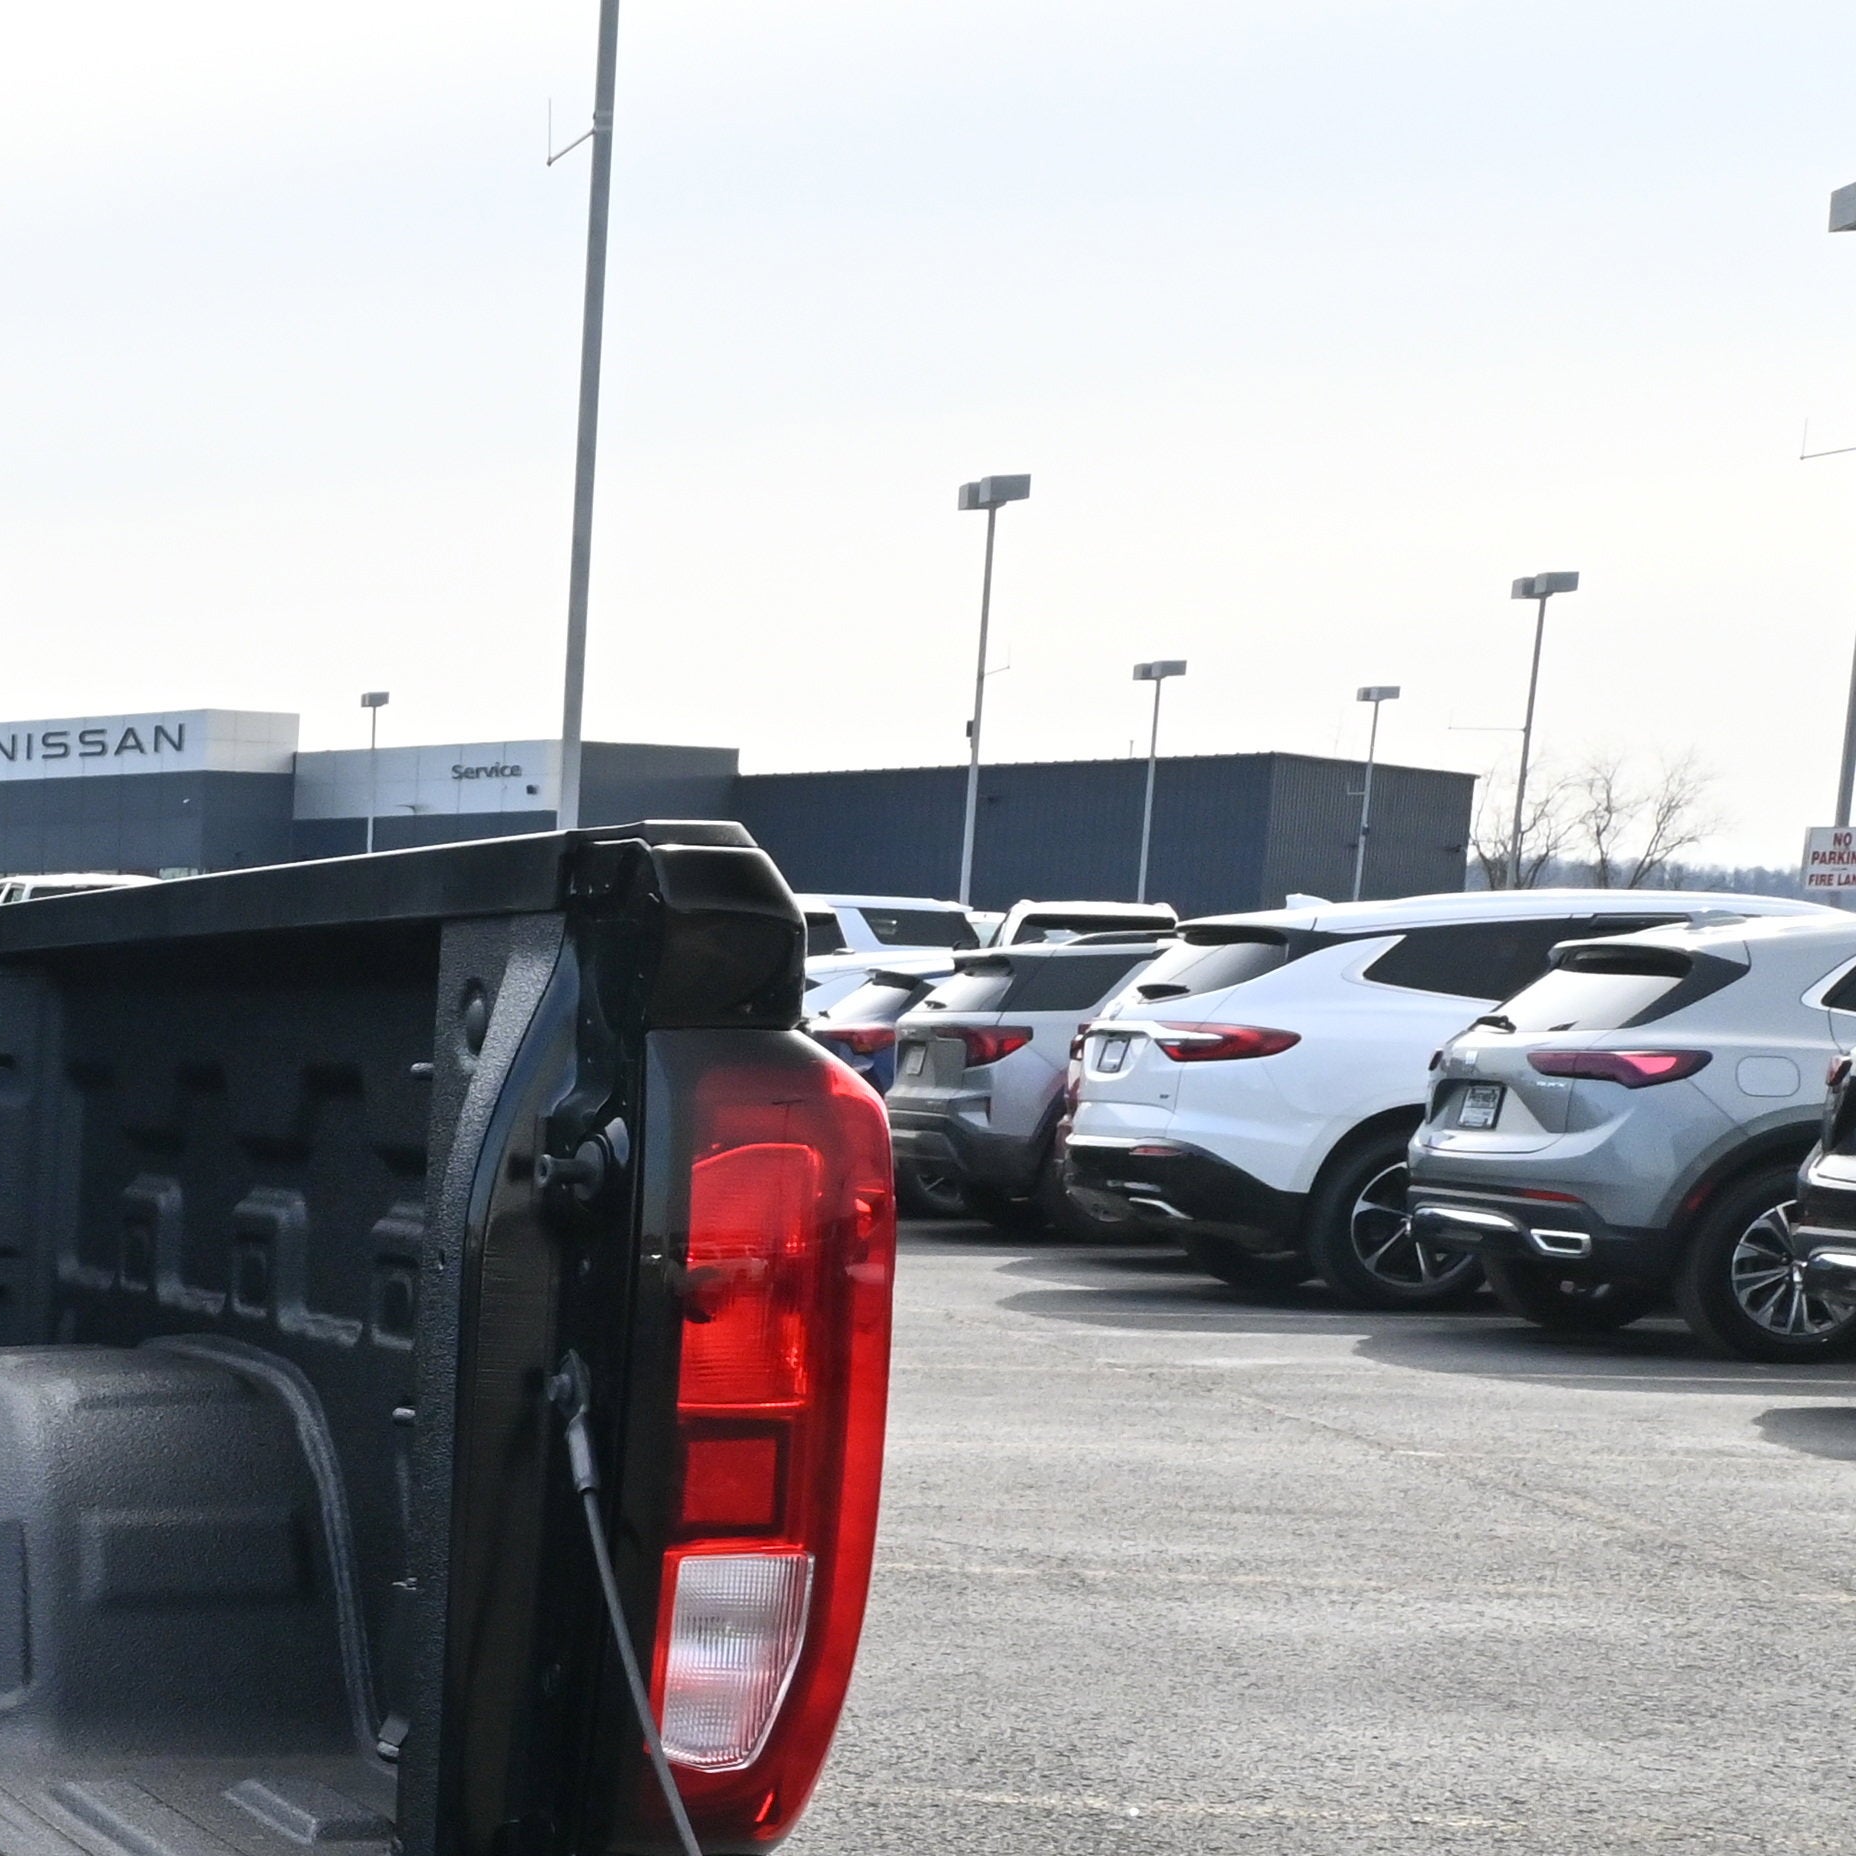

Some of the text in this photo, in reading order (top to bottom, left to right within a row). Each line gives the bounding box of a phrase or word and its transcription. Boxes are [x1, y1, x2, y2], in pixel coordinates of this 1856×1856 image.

[451, 762, 523, 780] Service
[1833, 832, 1853, 847] NO
[1808, 873, 1835, 886] FIRE
